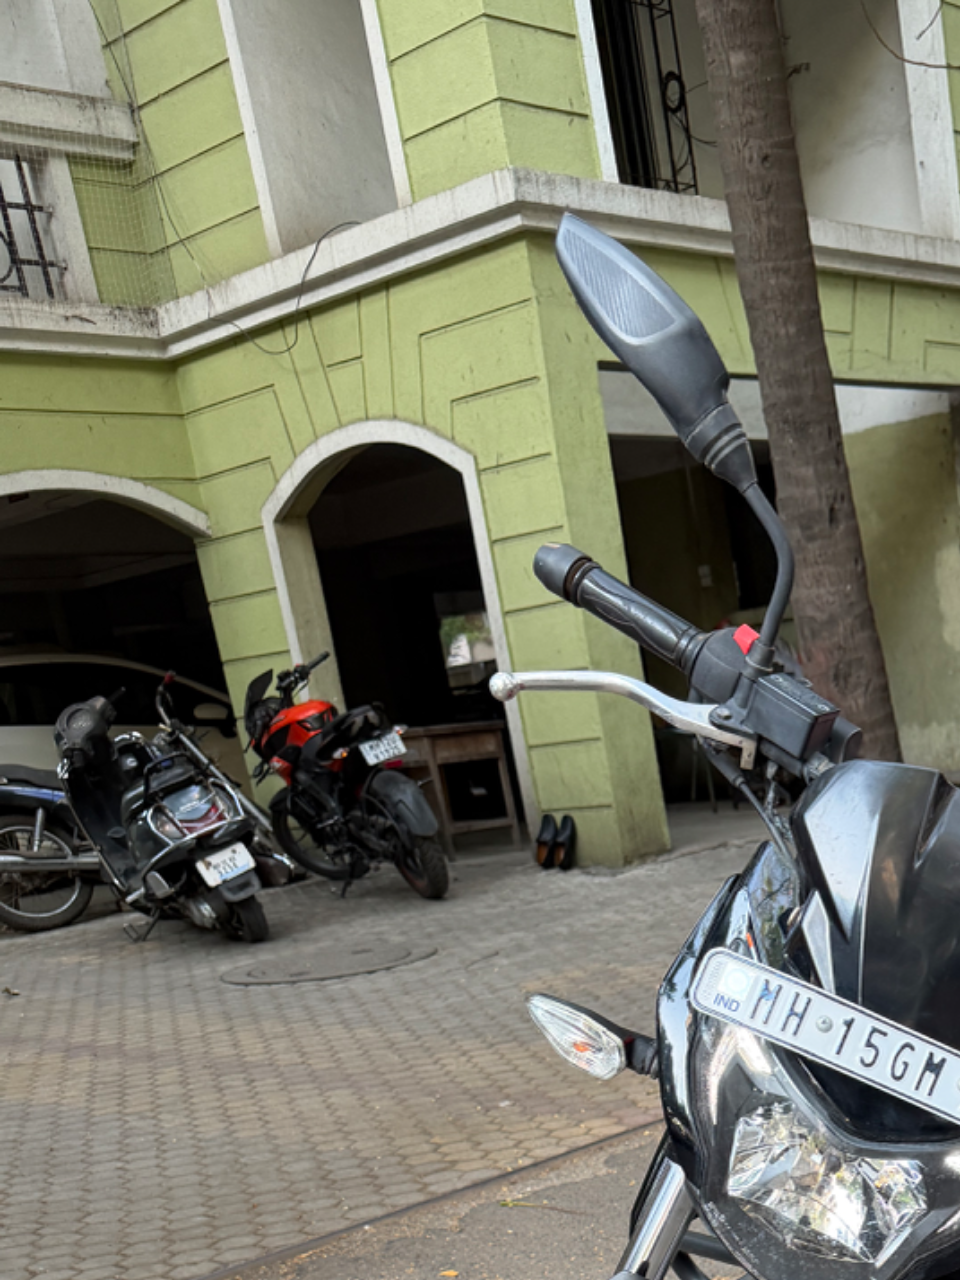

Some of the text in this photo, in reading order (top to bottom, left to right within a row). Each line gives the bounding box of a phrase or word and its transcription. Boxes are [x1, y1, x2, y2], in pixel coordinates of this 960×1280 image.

[713, 993, 741, 1013] IND
[750, 979, 812, 1037] MH
[835, 1016, 947, 1097] 15GM
